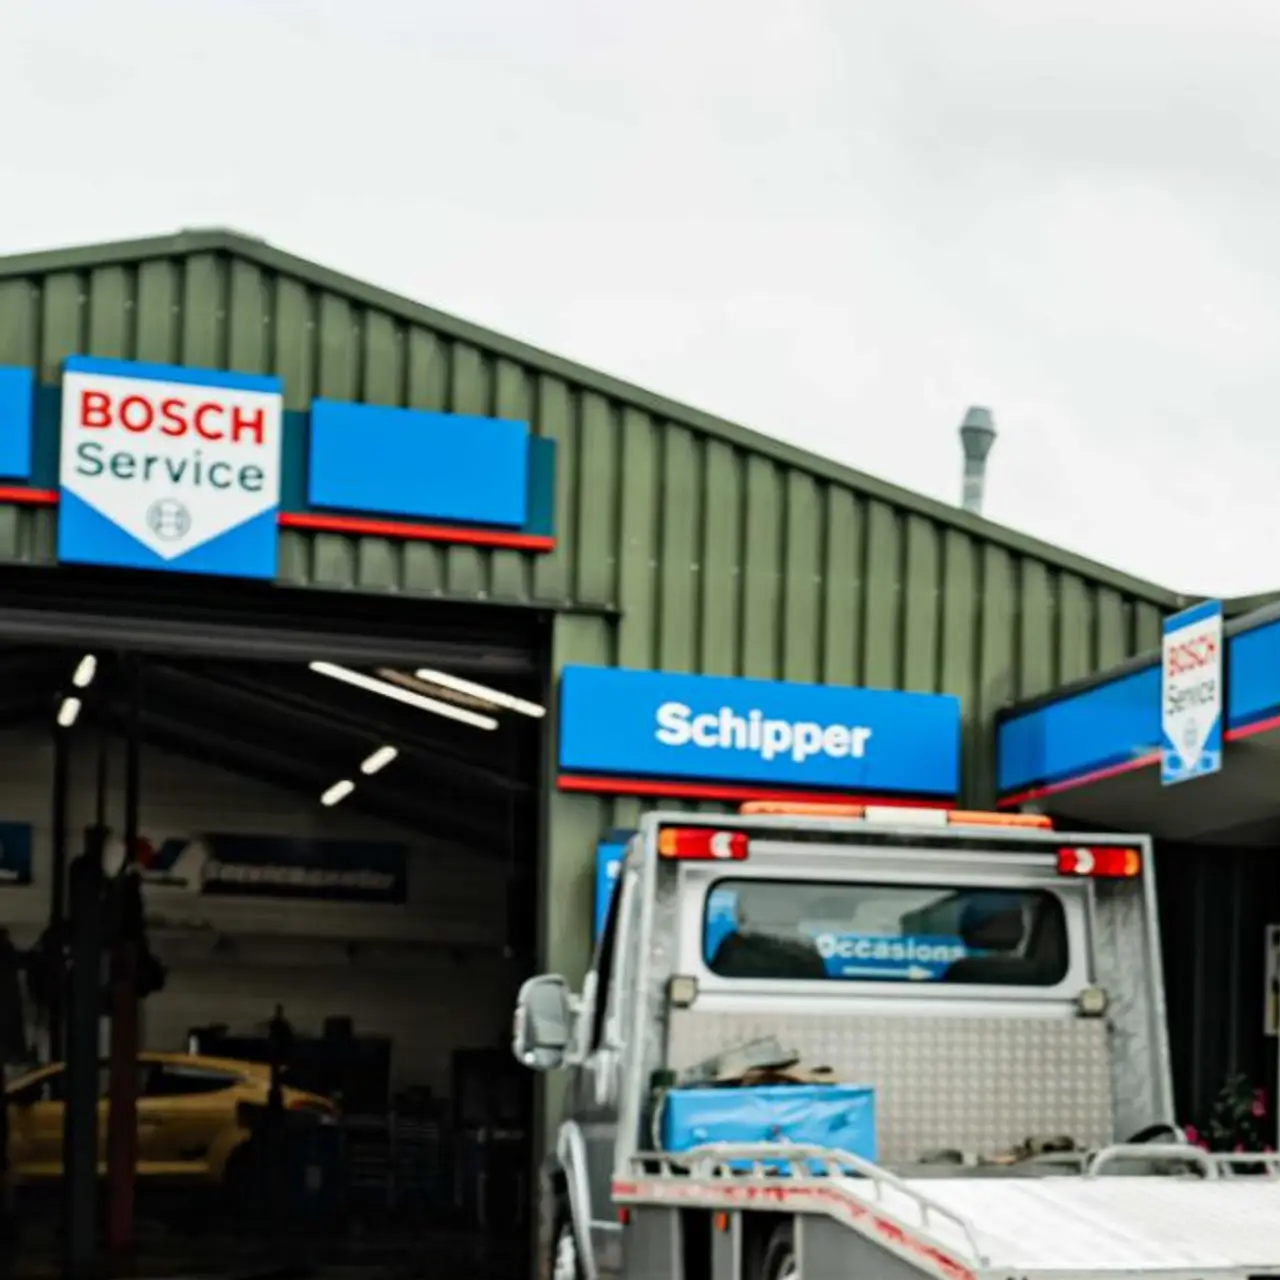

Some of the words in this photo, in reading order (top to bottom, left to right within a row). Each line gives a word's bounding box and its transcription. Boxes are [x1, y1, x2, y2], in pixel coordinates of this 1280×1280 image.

[79, 390, 265, 445] BOSCH
[75, 441, 265, 492] Service
[655, 701, 872, 761] Schipper
